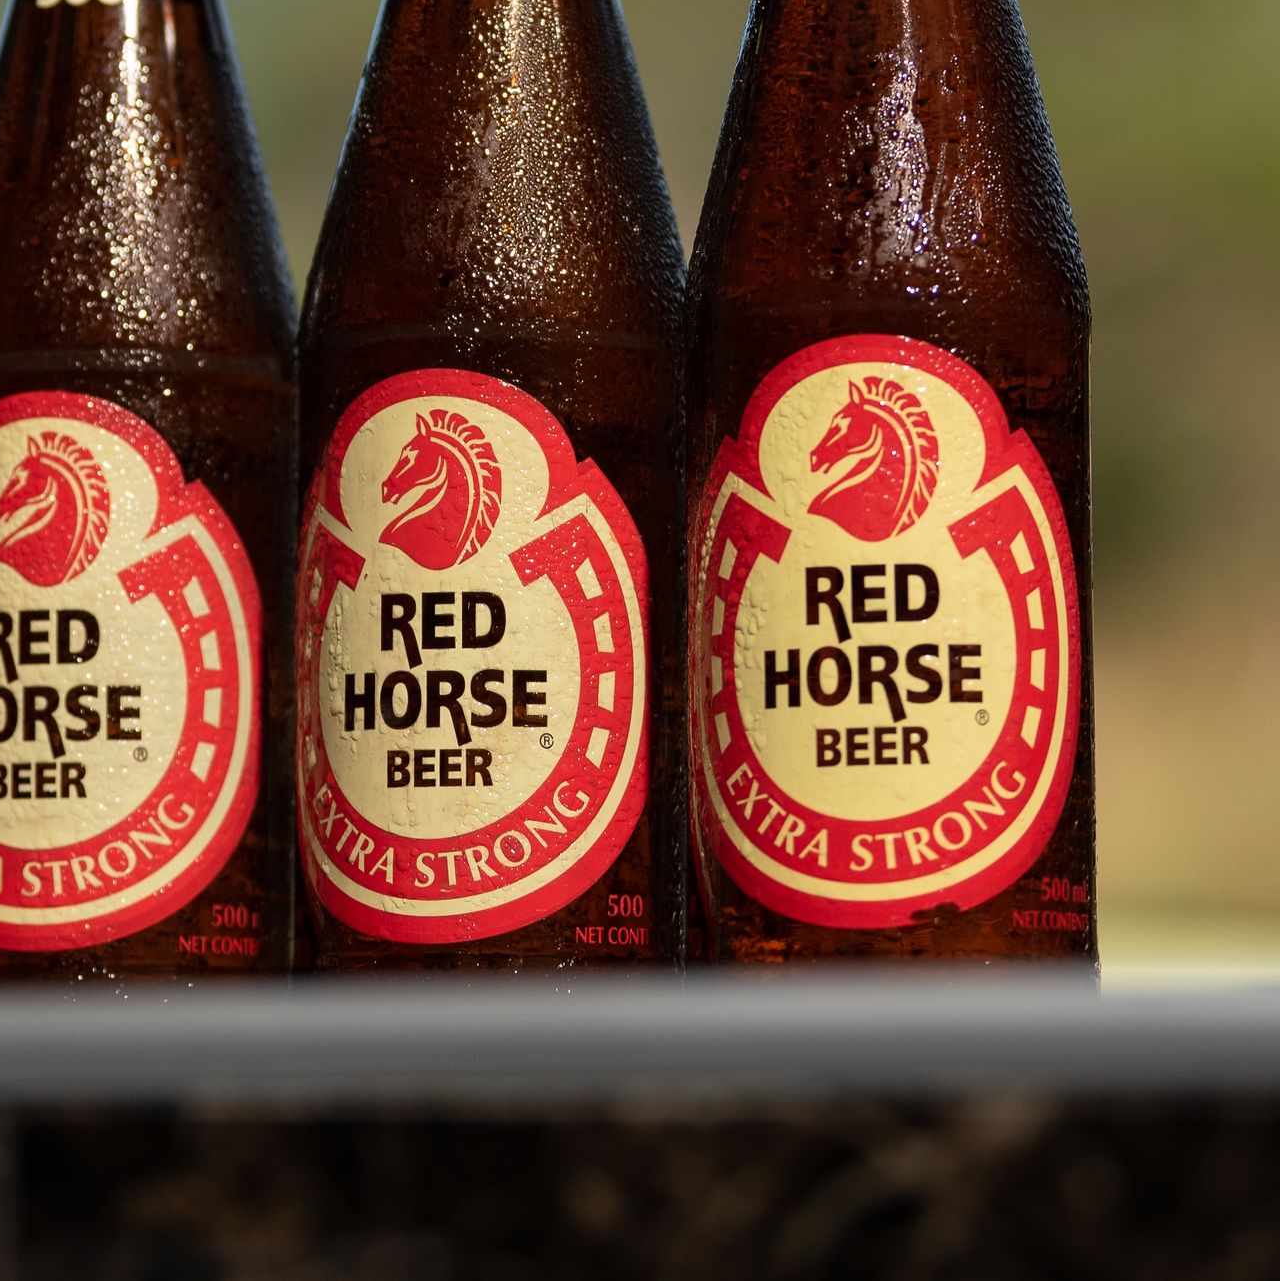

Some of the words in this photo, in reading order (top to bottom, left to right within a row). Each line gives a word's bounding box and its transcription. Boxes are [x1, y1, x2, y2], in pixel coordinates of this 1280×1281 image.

[805, 563, 940, 644] RED
[380, 591, 507, 667] RED
[764, 644, 984, 724] HORSE
[344, 669, 548, 746] HORSE
[386, 748, 493, 789] BEER
[815, 726, 930, 770] BEER
[312, 782, 396, 884] EXTRA
[414, 779, 591, 888] STRONG
[725, 761, 829, 869] EXTRA
[849, 761, 1026, 873] STRONG
[21, 793, 195, 897] STRONG
[607, 894, 644, 918] 500
[1041, 877, 1071, 902] 500
[211, 904, 249, 928] 500
[575, 926, 605, 944] NET
[1011, 909, 1039, 928] NET
[179, 935, 207, 954] NET
